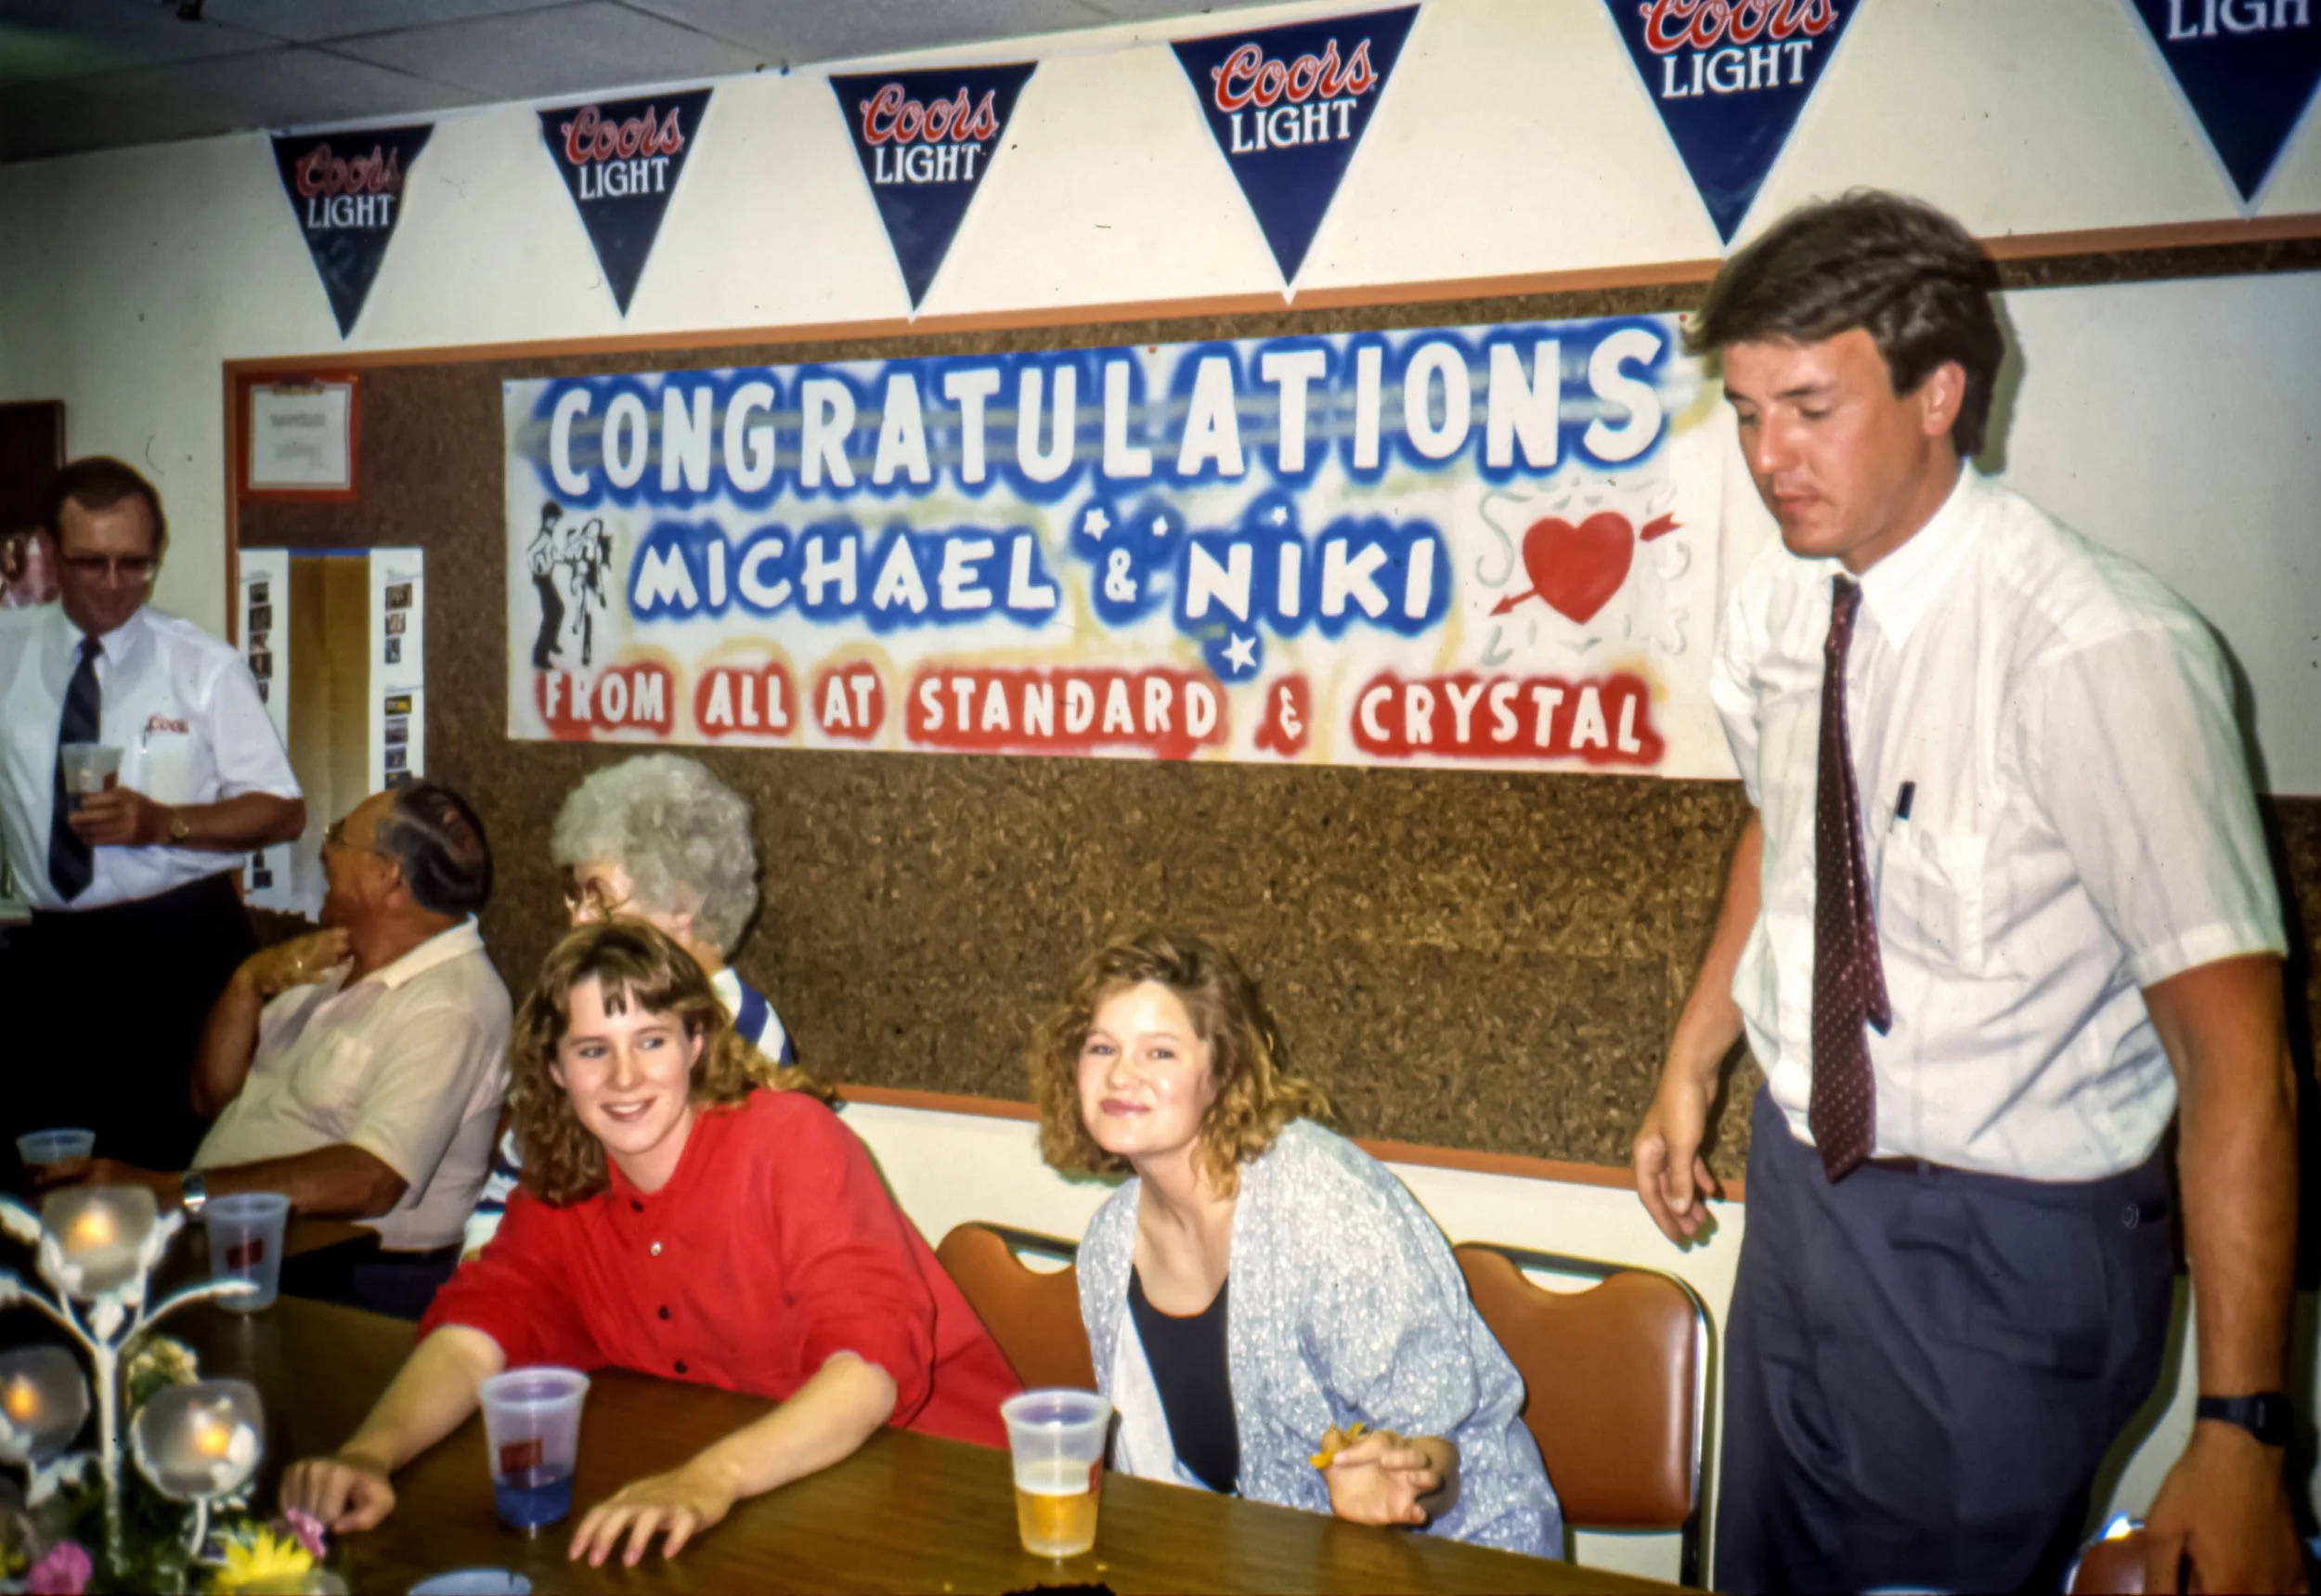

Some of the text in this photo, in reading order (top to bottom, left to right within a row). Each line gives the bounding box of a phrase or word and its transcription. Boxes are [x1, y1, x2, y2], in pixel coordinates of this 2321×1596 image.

[1640, 0, 1838, 54] Coors
[2167, 0, 2311, 41] LIGH
[1211, 38, 1378, 112] Coors
[1661, 39, 1814, 98] LIGHT
[561, 105, 684, 165] Coors
[860, 84, 999, 144] Coors
[1229, 97, 1357, 154] LIGHT
[295, 142, 401, 198] Coors
[578, 156, 669, 200] LIGHT
[874, 142, 982, 185] LIGHT
[306, 192, 396, 229] LIGHT
[550, 328, 1663, 496] CONGRATULATIONS
[633, 532, 1057, 614] MICHAEL
[1104, 547, 1137, 603] &
[546, 670, 1650, 754] FROM ALL AT STANDARD & CRYSTAL
